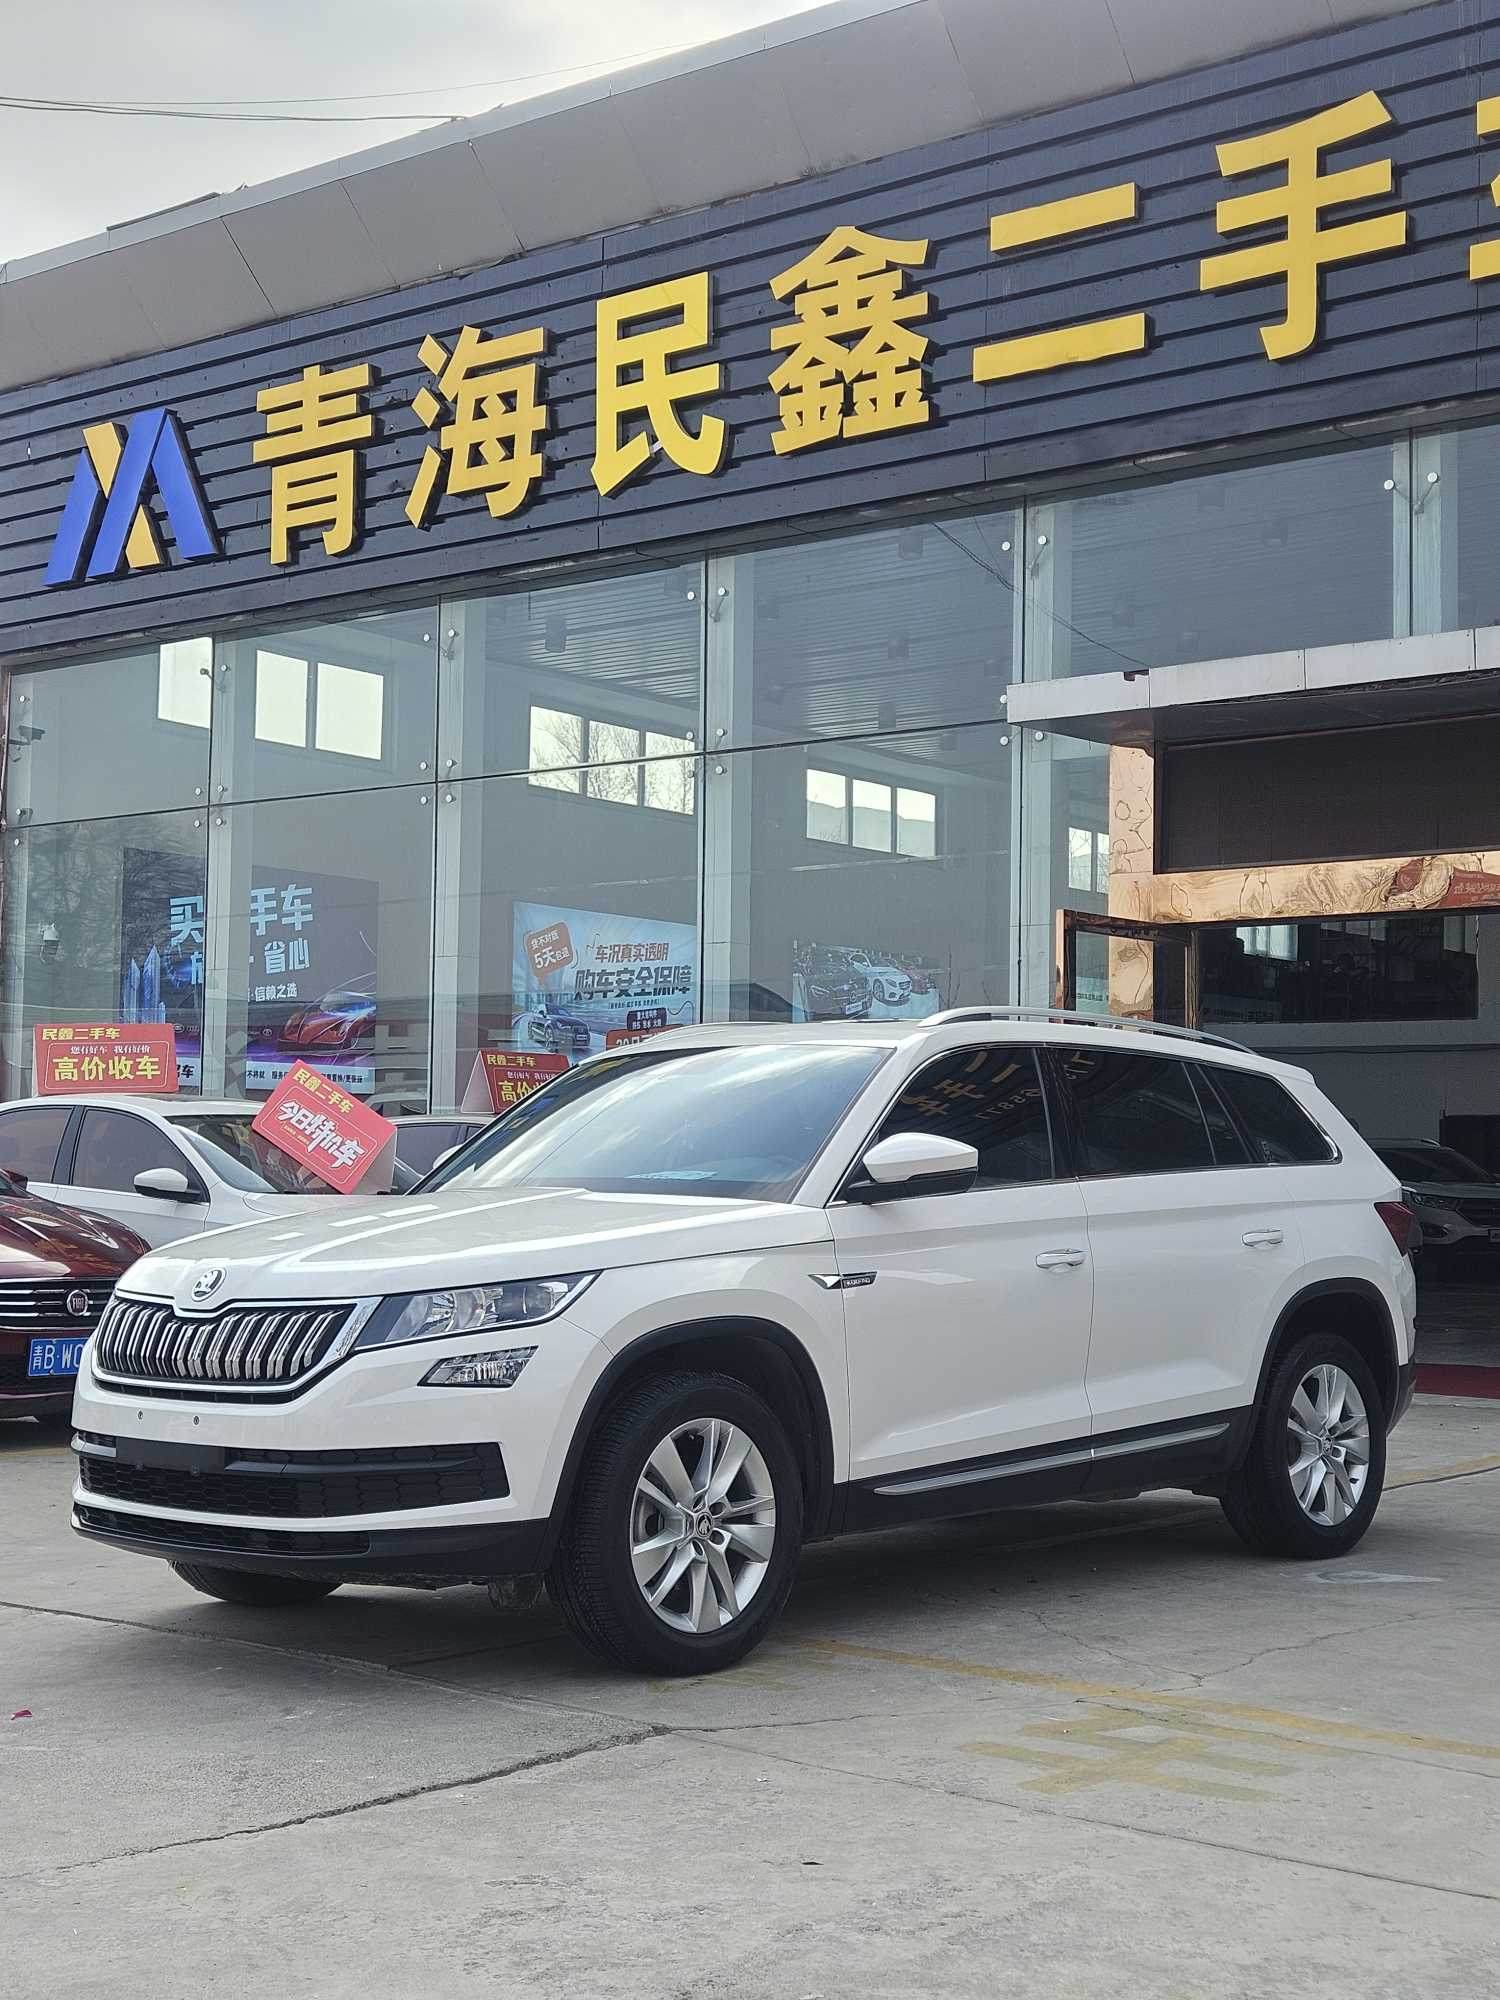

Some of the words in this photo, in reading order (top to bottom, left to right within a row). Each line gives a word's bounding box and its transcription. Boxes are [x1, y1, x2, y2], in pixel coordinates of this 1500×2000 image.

[252, 90, 1500, 565] 青海民鑫二手
[595, 943, 670, 963] 车况真实透明
[574, 965, 692, 1000] 购车安全保障
[42, 1028, 120, 1040] 民鑫二手车
[53, 1056, 160, 1081] 高价收车
[487, 1055, 536, 1067] 民鑫二手车
[293, 1068, 354, 1113] 民鑫二手车
[277, 1100, 367, 1168] 今日特价车
[72, 1297, 84, 1310] FIAT
